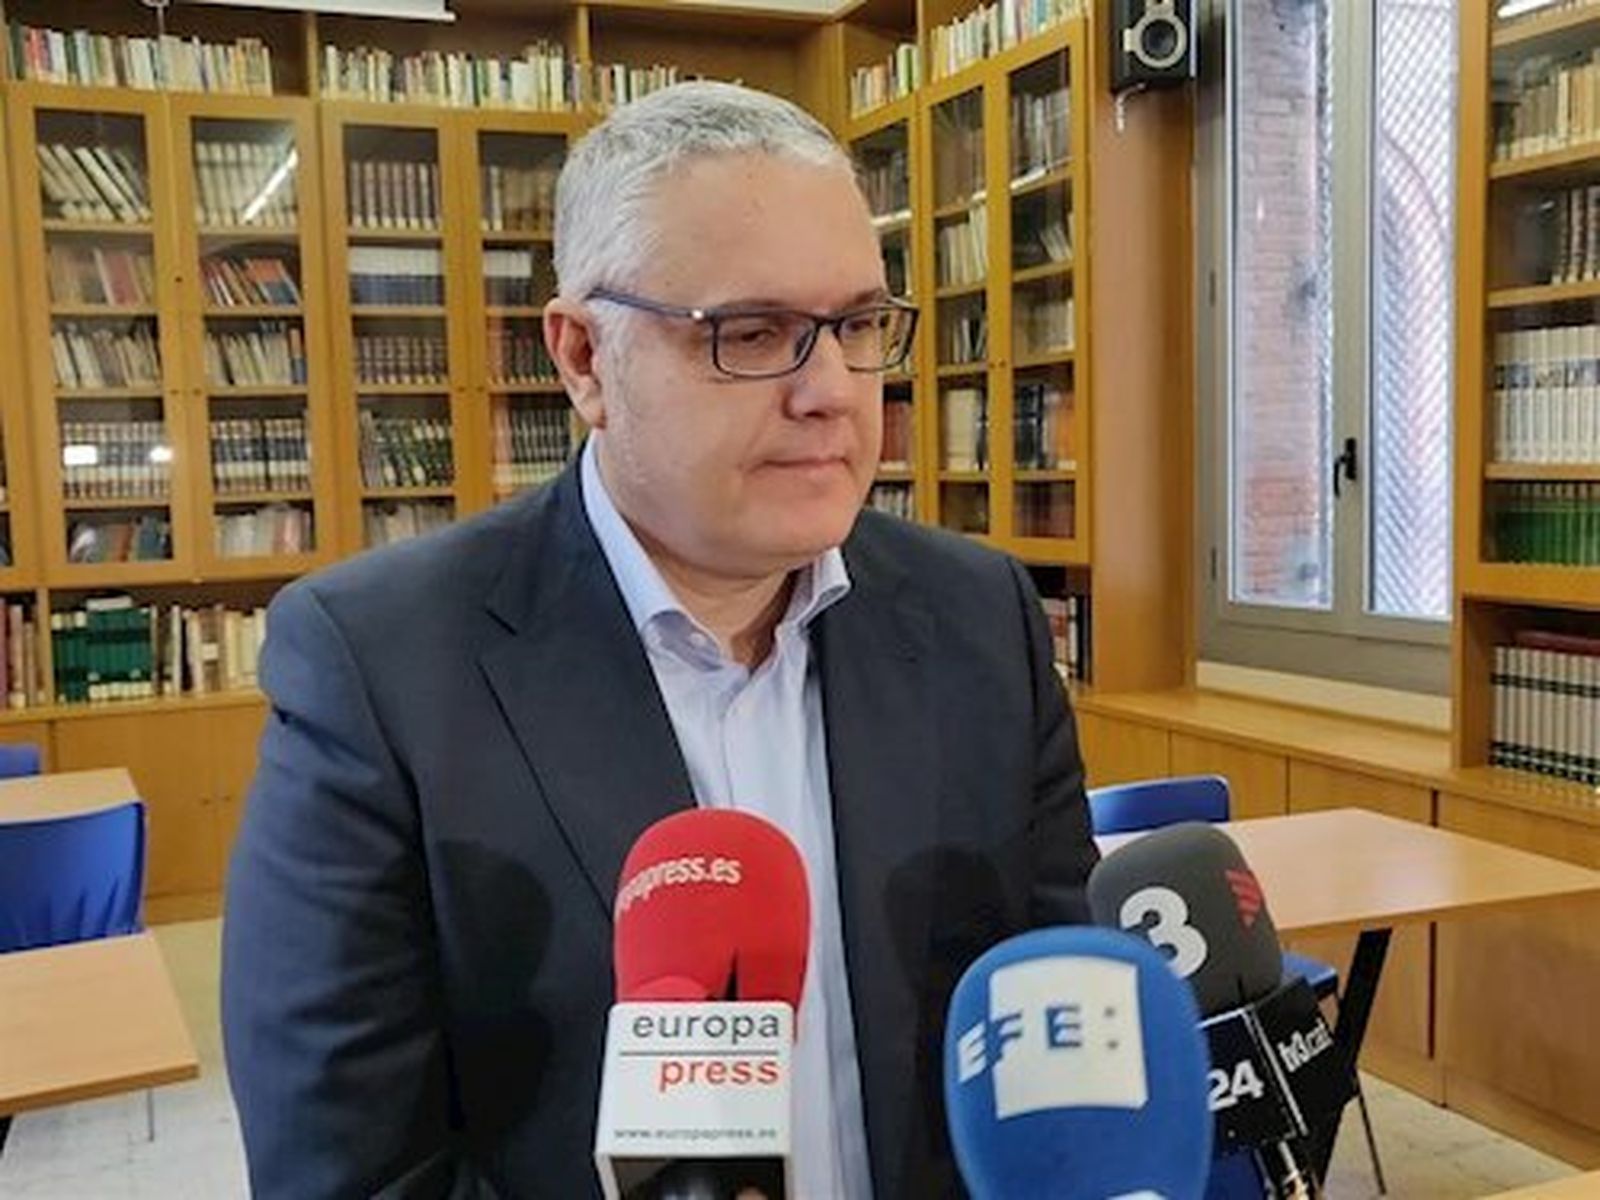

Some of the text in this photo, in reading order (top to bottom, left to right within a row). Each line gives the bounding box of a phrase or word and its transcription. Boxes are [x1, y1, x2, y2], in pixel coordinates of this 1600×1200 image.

[1119, 886, 1208, 980] 3
[632, 1013, 780, 1045] europa
[659, 1060, 780, 1093] press
